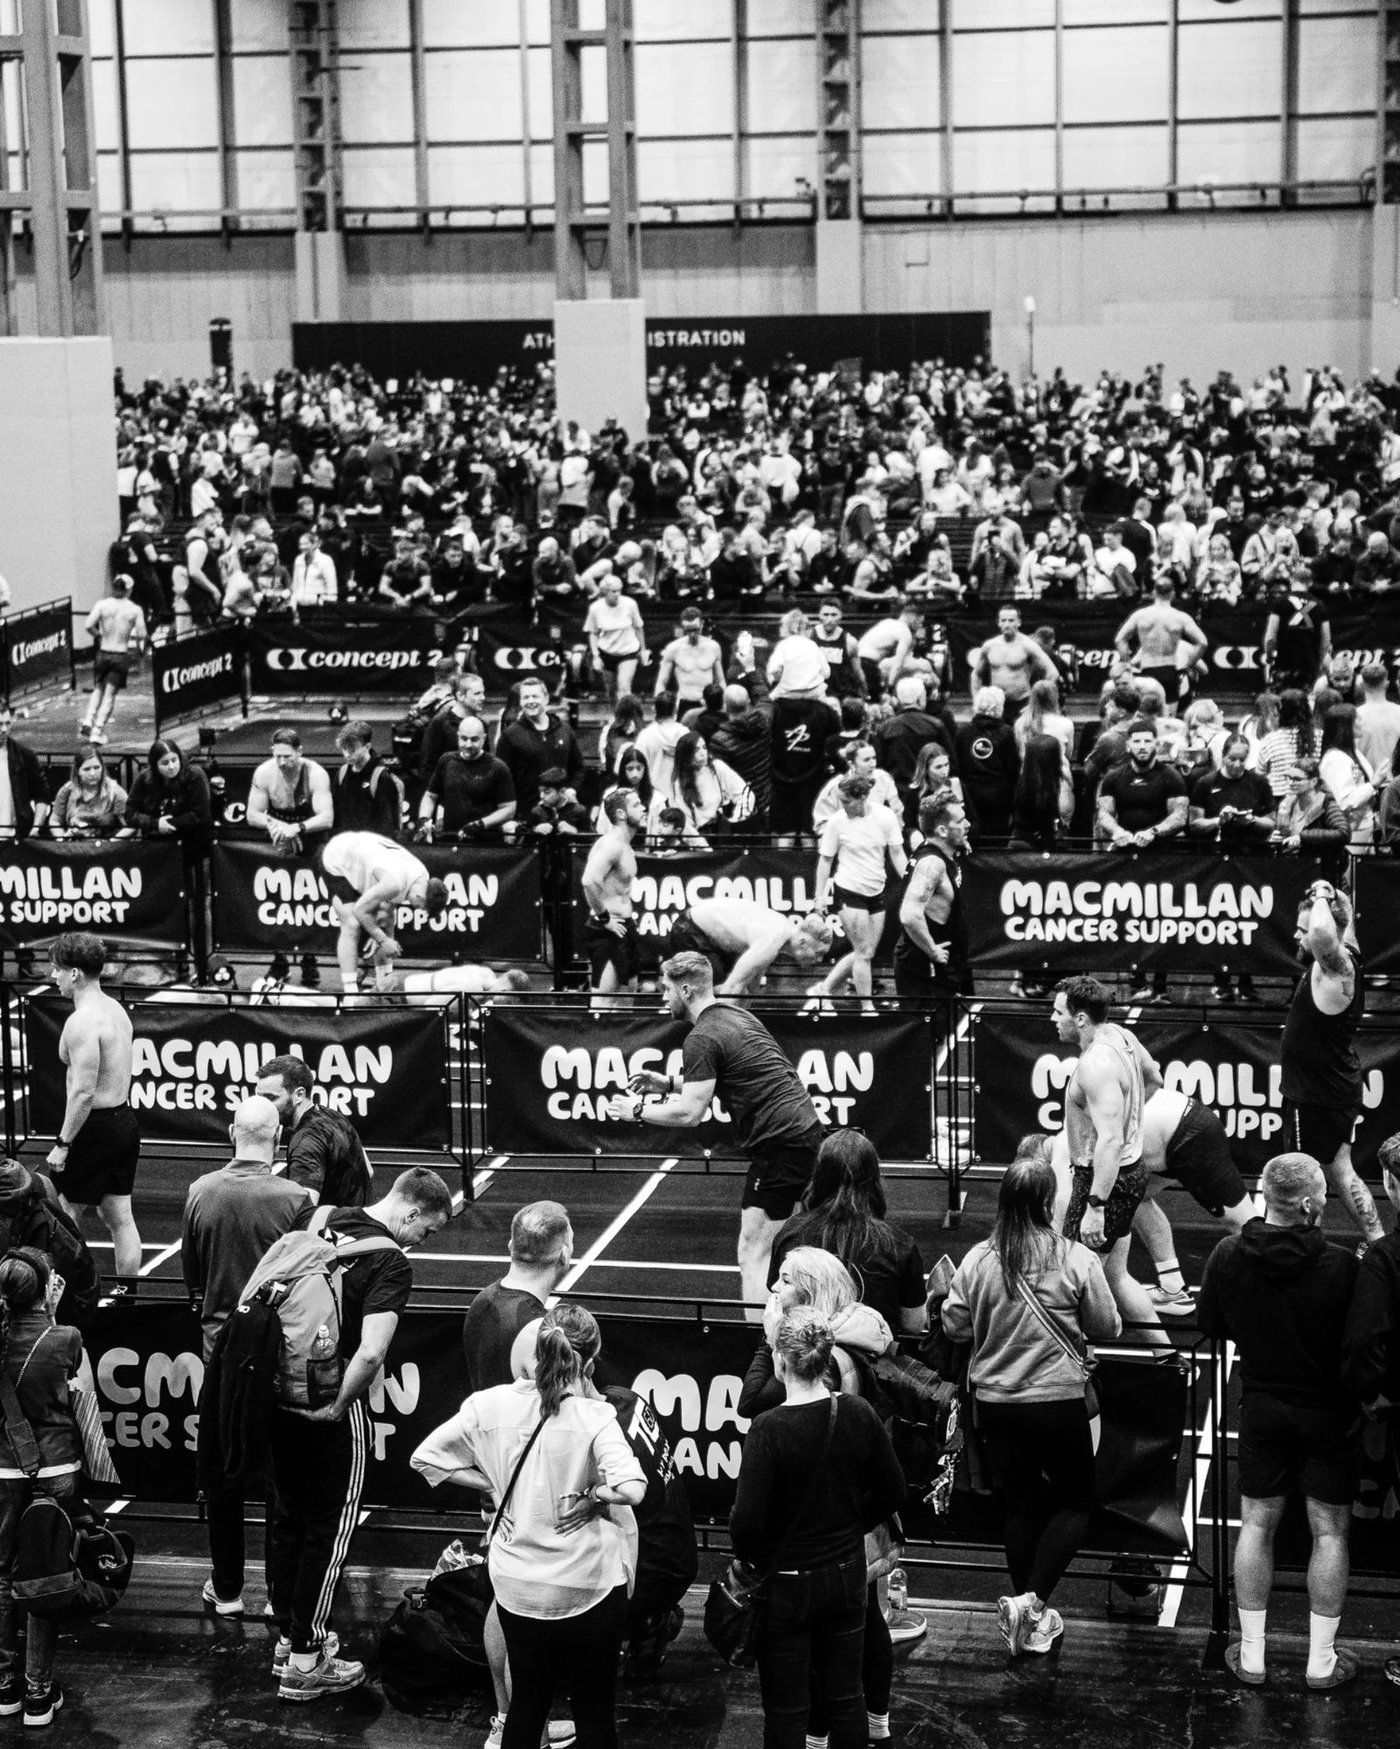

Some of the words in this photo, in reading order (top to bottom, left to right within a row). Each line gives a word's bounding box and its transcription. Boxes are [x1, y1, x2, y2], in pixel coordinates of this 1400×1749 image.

[26, 633, 59, 658] concept
[60, 630, 66, 646] 2
[180, 657, 223, 684] concept
[225, 653, 232, 670] 2
[309, 648, 421, 670] concept
[427, 649, 443, 668] 2
[10, 901, 130, 924] SUPPORT
[1001, 879, 1273, 918] MACMILLAN
[1004, 917, 1118, 943] CANCER
[1126, 920, 1258, 945] SUPPORT
